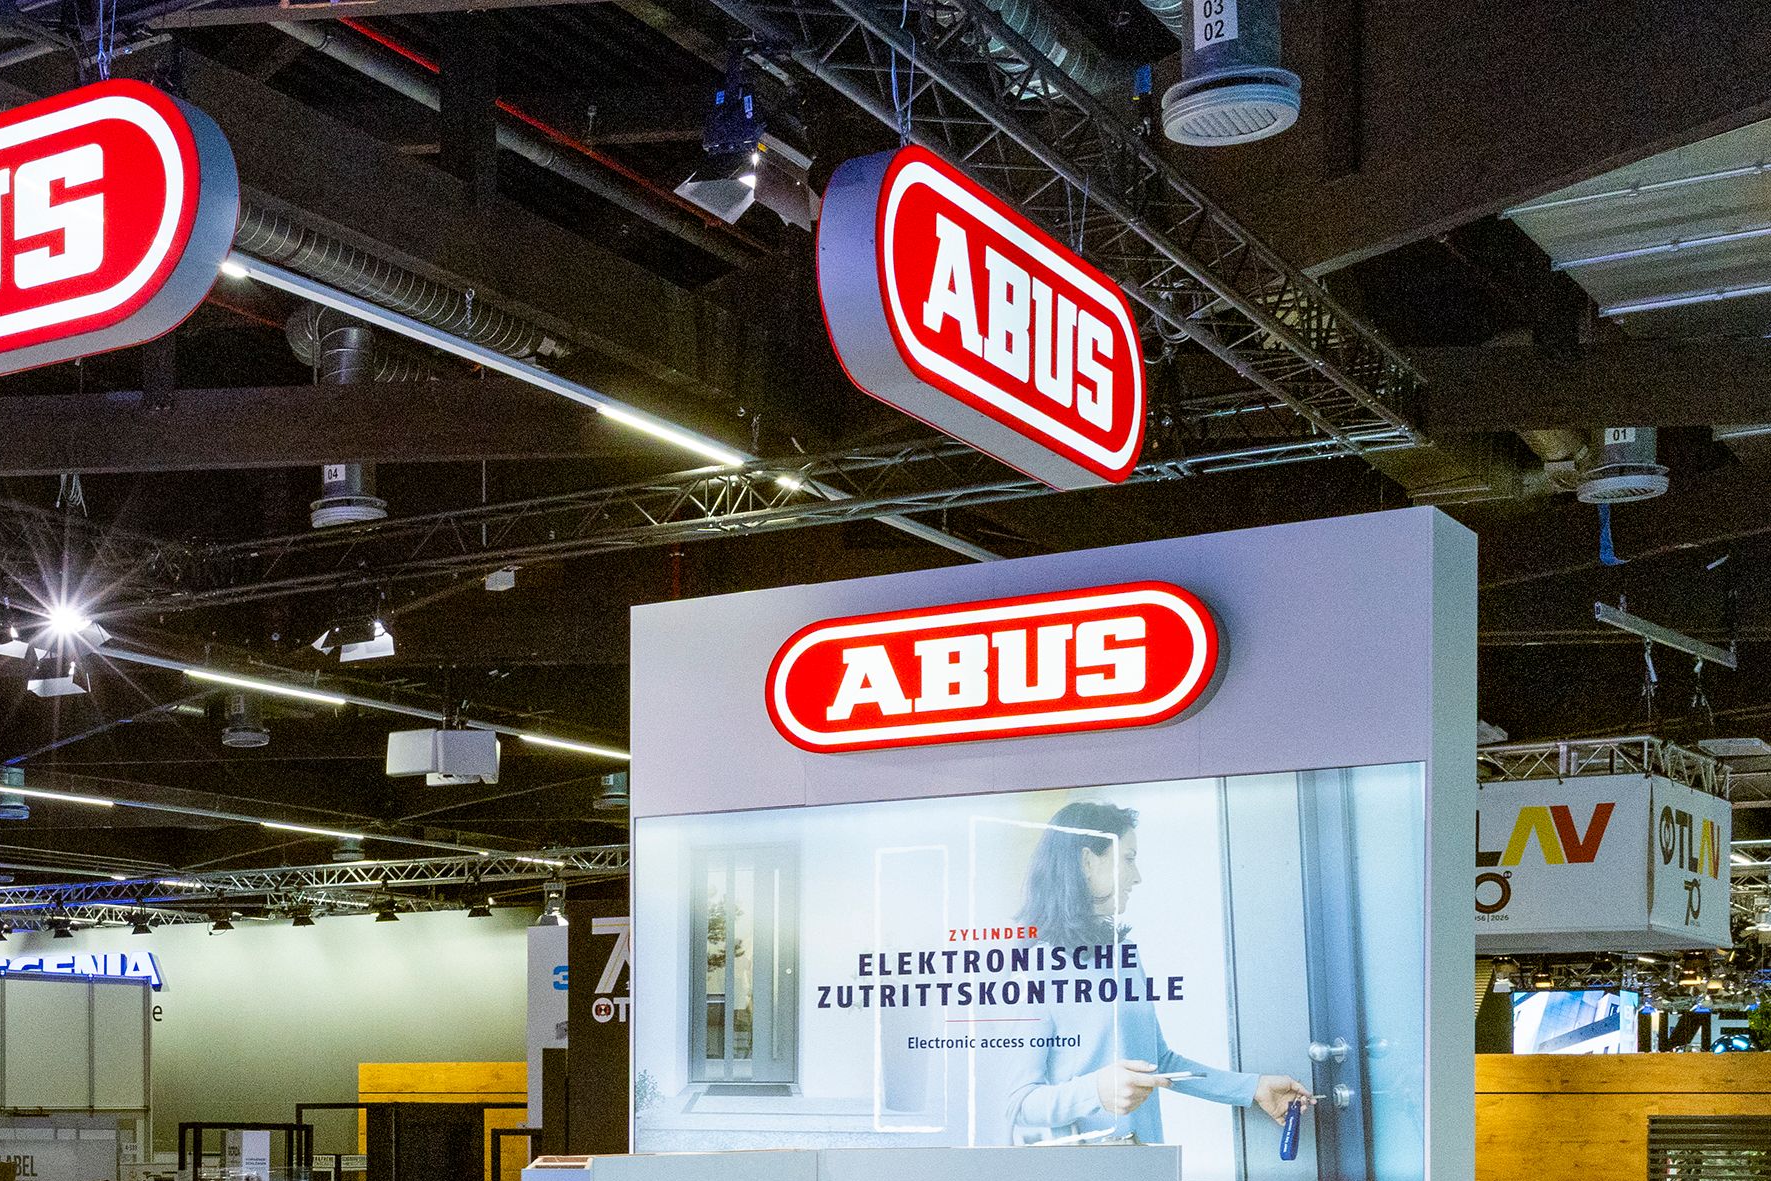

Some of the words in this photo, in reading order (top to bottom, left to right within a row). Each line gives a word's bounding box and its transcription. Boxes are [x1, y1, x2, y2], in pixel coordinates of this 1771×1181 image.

[1204, 20, 1225, 41] 02
[923, 213, 1113, 432] ABUS
[1613, 429, 1627, 441] 01
[327, 468, 338, 480] 04
[827, 617, 1145, 720] ABUS
[948, 926, 1038, 942] ZYLINDER
[858, 944, 1138, 977] ELEKTRONISCHE
[817, 976, 1184, 1009] ZUTRITTSKONTROLLE
[907, 1036, 976, 1049] Electronic
[980, 1037, 1025, 1049] access
[1029, 1034, 1081, 1048] control
